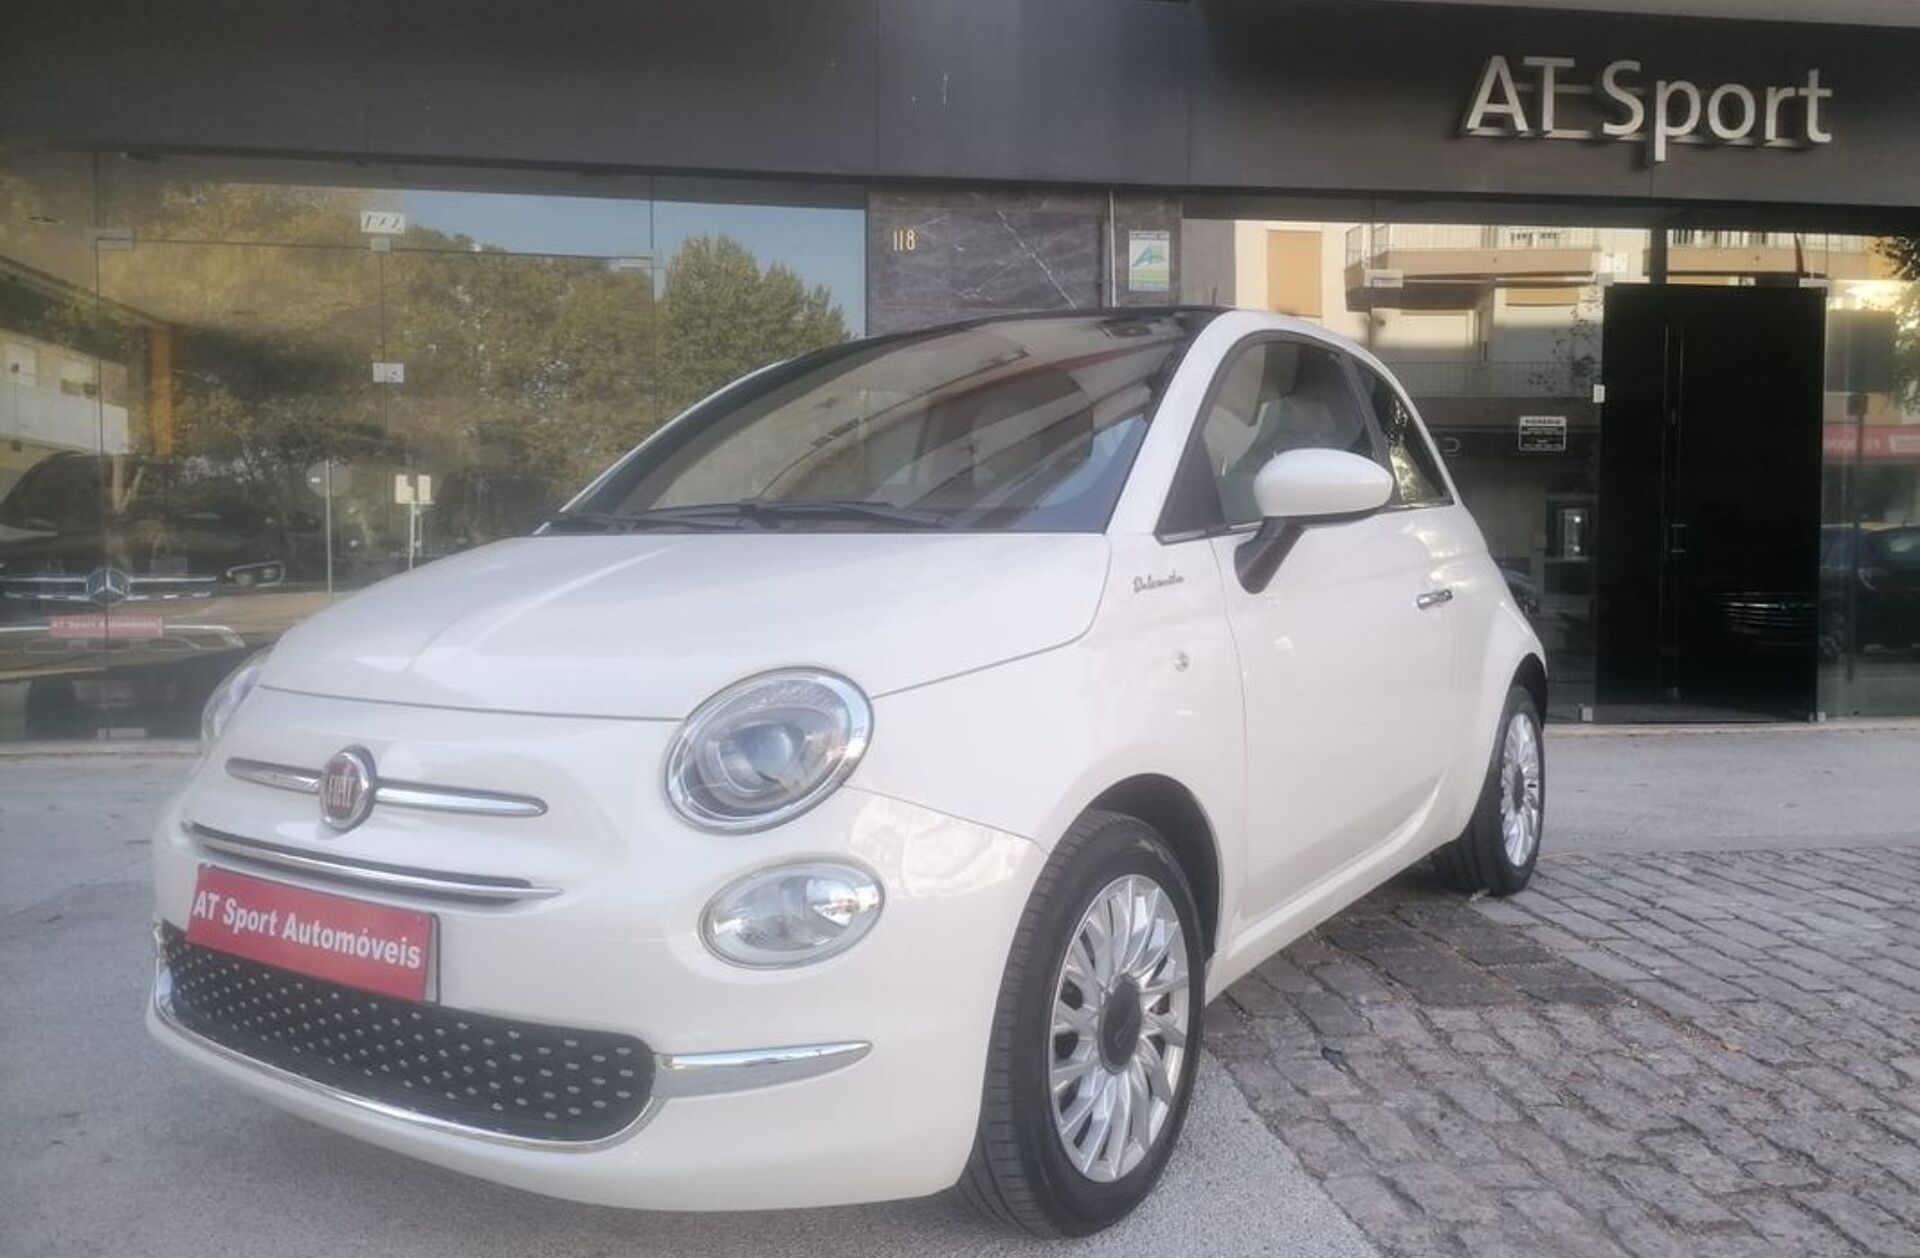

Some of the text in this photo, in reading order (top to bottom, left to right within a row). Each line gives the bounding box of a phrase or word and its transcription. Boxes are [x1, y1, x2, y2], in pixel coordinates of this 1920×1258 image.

[1466, 55, 1833, 162] AT Sport
[893, 229, 916, 251] 118
[328, 774, 356, 809] FIAT
[192, 890, 422, 970] AT Sport Automóveis
